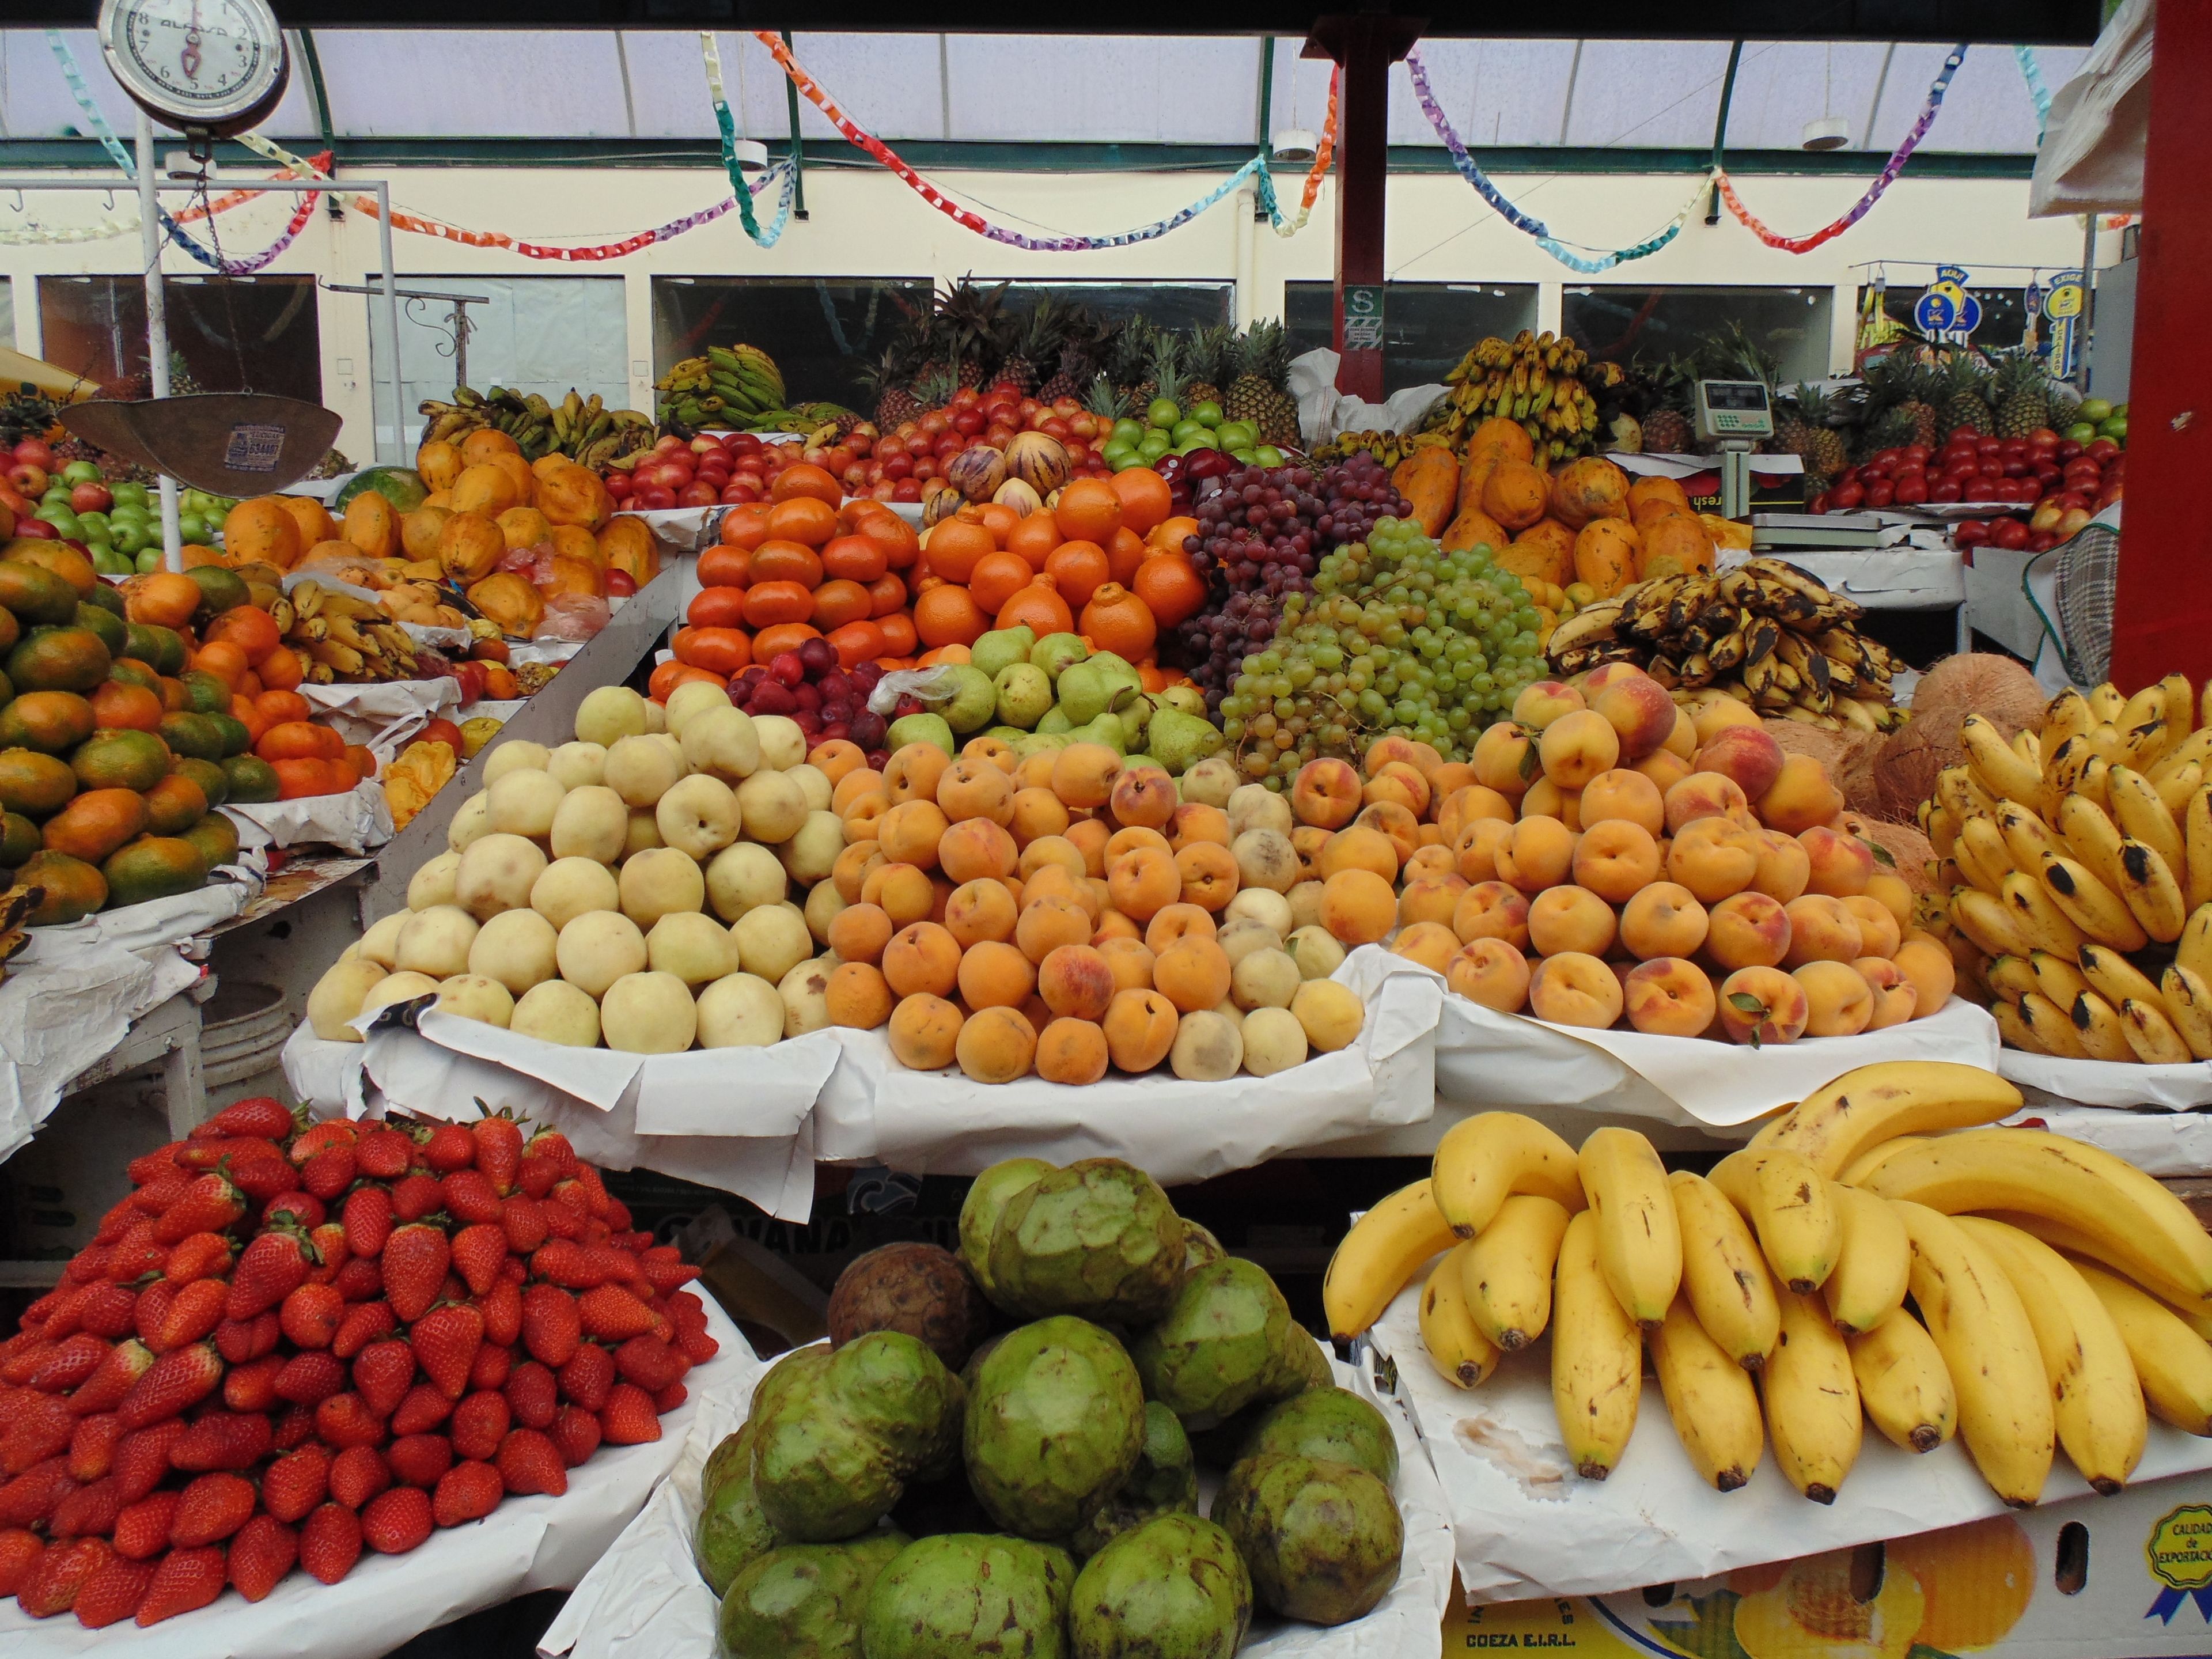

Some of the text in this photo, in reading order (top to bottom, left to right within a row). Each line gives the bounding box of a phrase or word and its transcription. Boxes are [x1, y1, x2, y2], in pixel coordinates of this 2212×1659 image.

[221, 3, 227, 15] 1
[139, 12, 149, 25] 8
[238, 27, 247, 40] 2
[139, 40, 149, 52] 7
[238, 55, 248, 68] 3
[160, 65, 171, 78] 6
[189, 76, 199, 90] 5
[218, 73, 228, 86] 4
[1351, 290, 1374, 314] S
